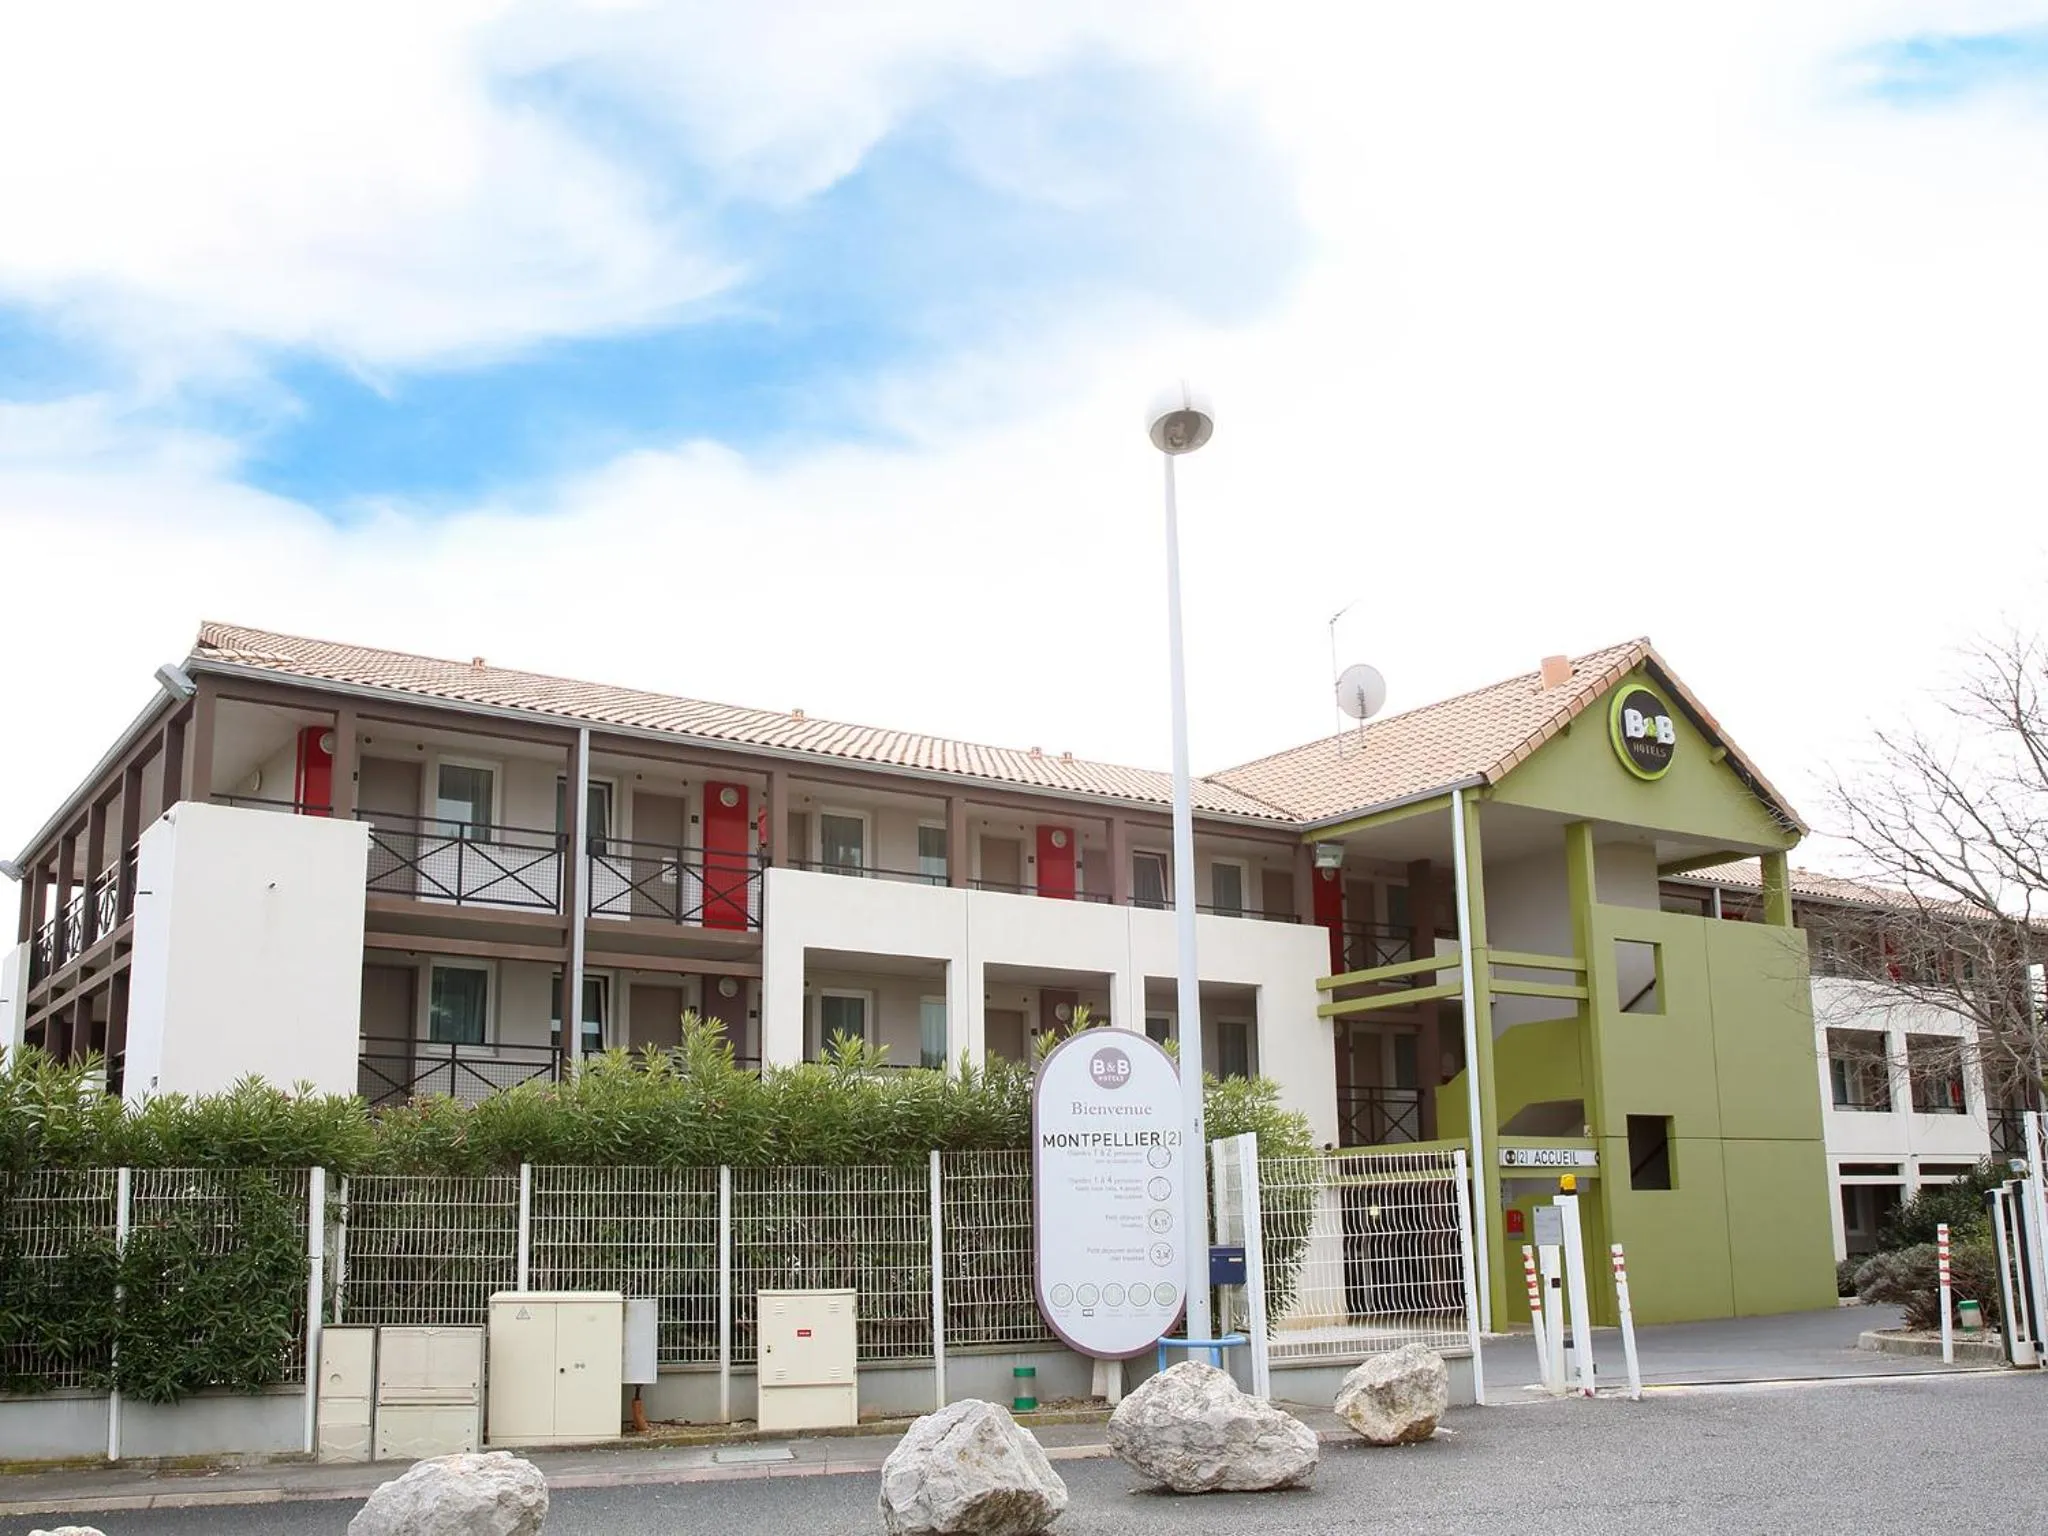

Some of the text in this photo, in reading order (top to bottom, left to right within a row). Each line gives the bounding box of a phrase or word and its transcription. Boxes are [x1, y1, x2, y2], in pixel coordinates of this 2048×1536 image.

[1624, 708, 1676, 745] B&B
[1632, 742, 1667, 758] HOTELS
[1092, 1059, 1130, 1075] B&B
[1071, 1101, 1153, 1116] Bienvenue
[1534, 1150, 1579, 1165] ACCUEIL
